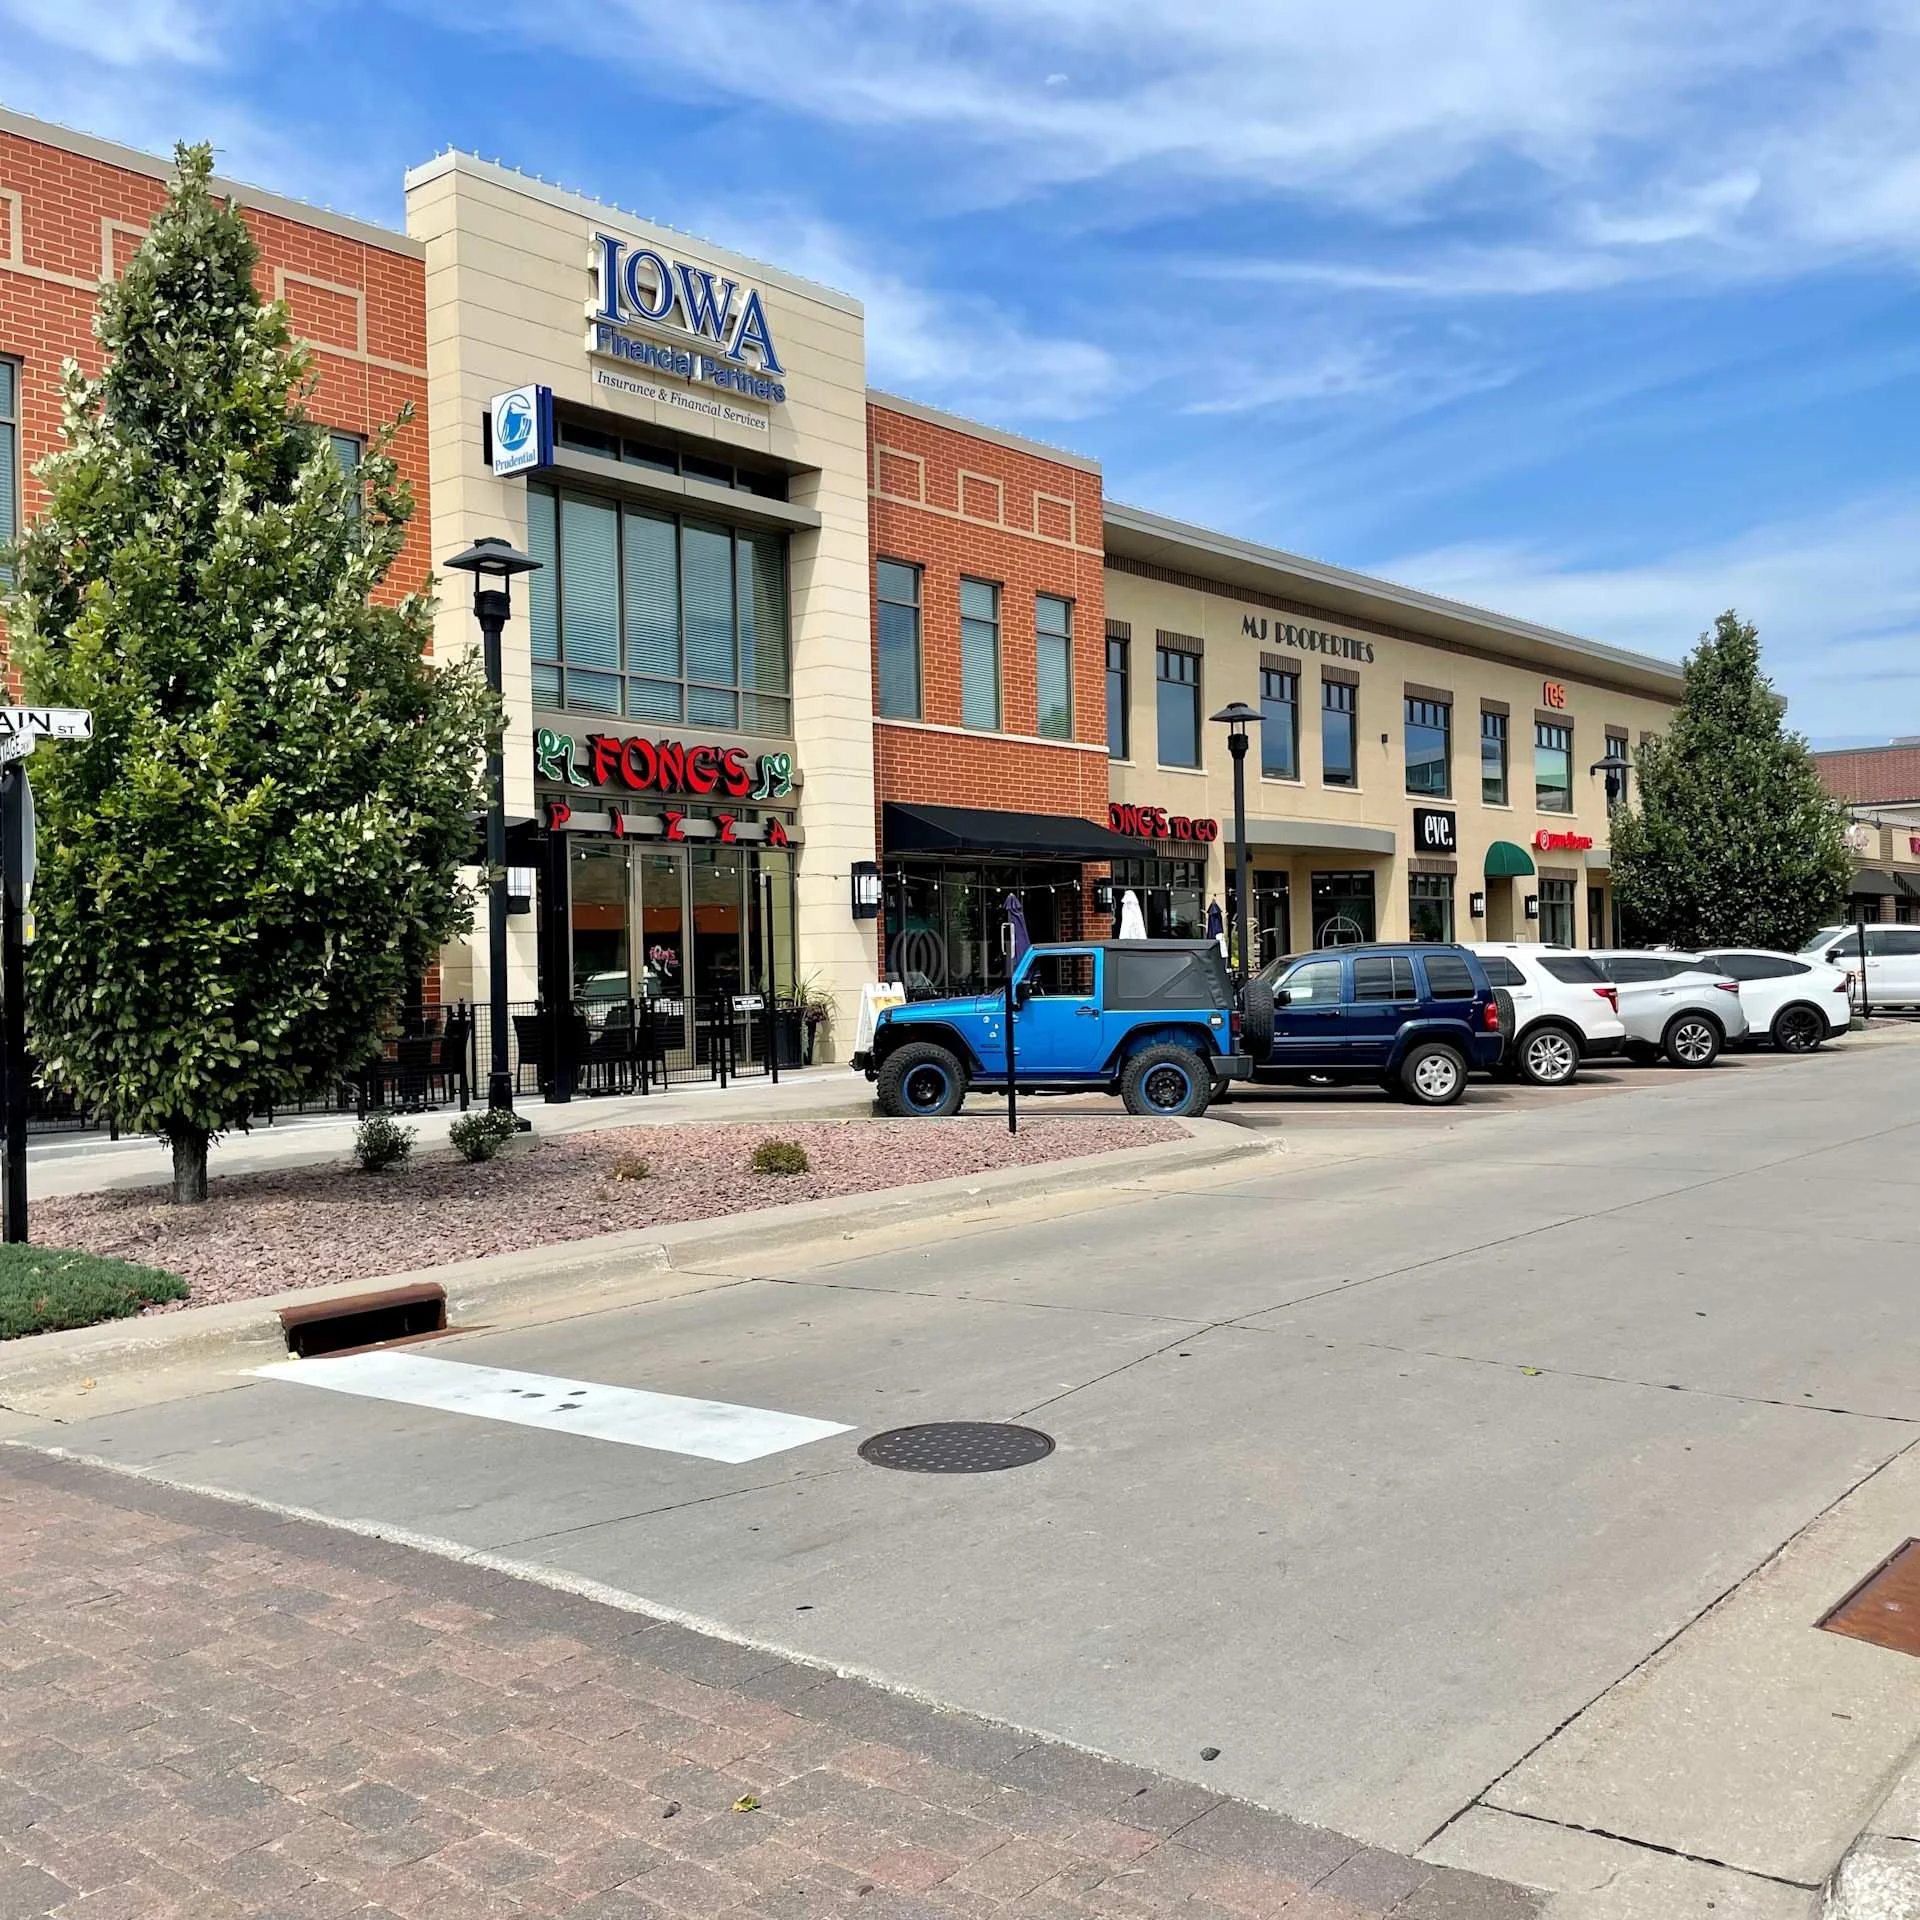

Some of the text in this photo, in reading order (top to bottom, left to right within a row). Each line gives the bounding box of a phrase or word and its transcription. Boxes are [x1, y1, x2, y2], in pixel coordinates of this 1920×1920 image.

[596, 232, 786, 376] IOWA
[597, 324, 787, 404] Financial Partners
[598, 371, 766, 430] Insurance & Financial Services
[495, 449, 536, 471] Prudential
[1241, 614, 1374, 664] MJ PROPERTIES
[58, 726, 75, 734] ST
[585, 734, 750, 797] FONG'S
[547, 802, 787, 847] PIZZA
[1168, 816, 1192, 840] TO
[1192, 819, 1217, 841] GO
